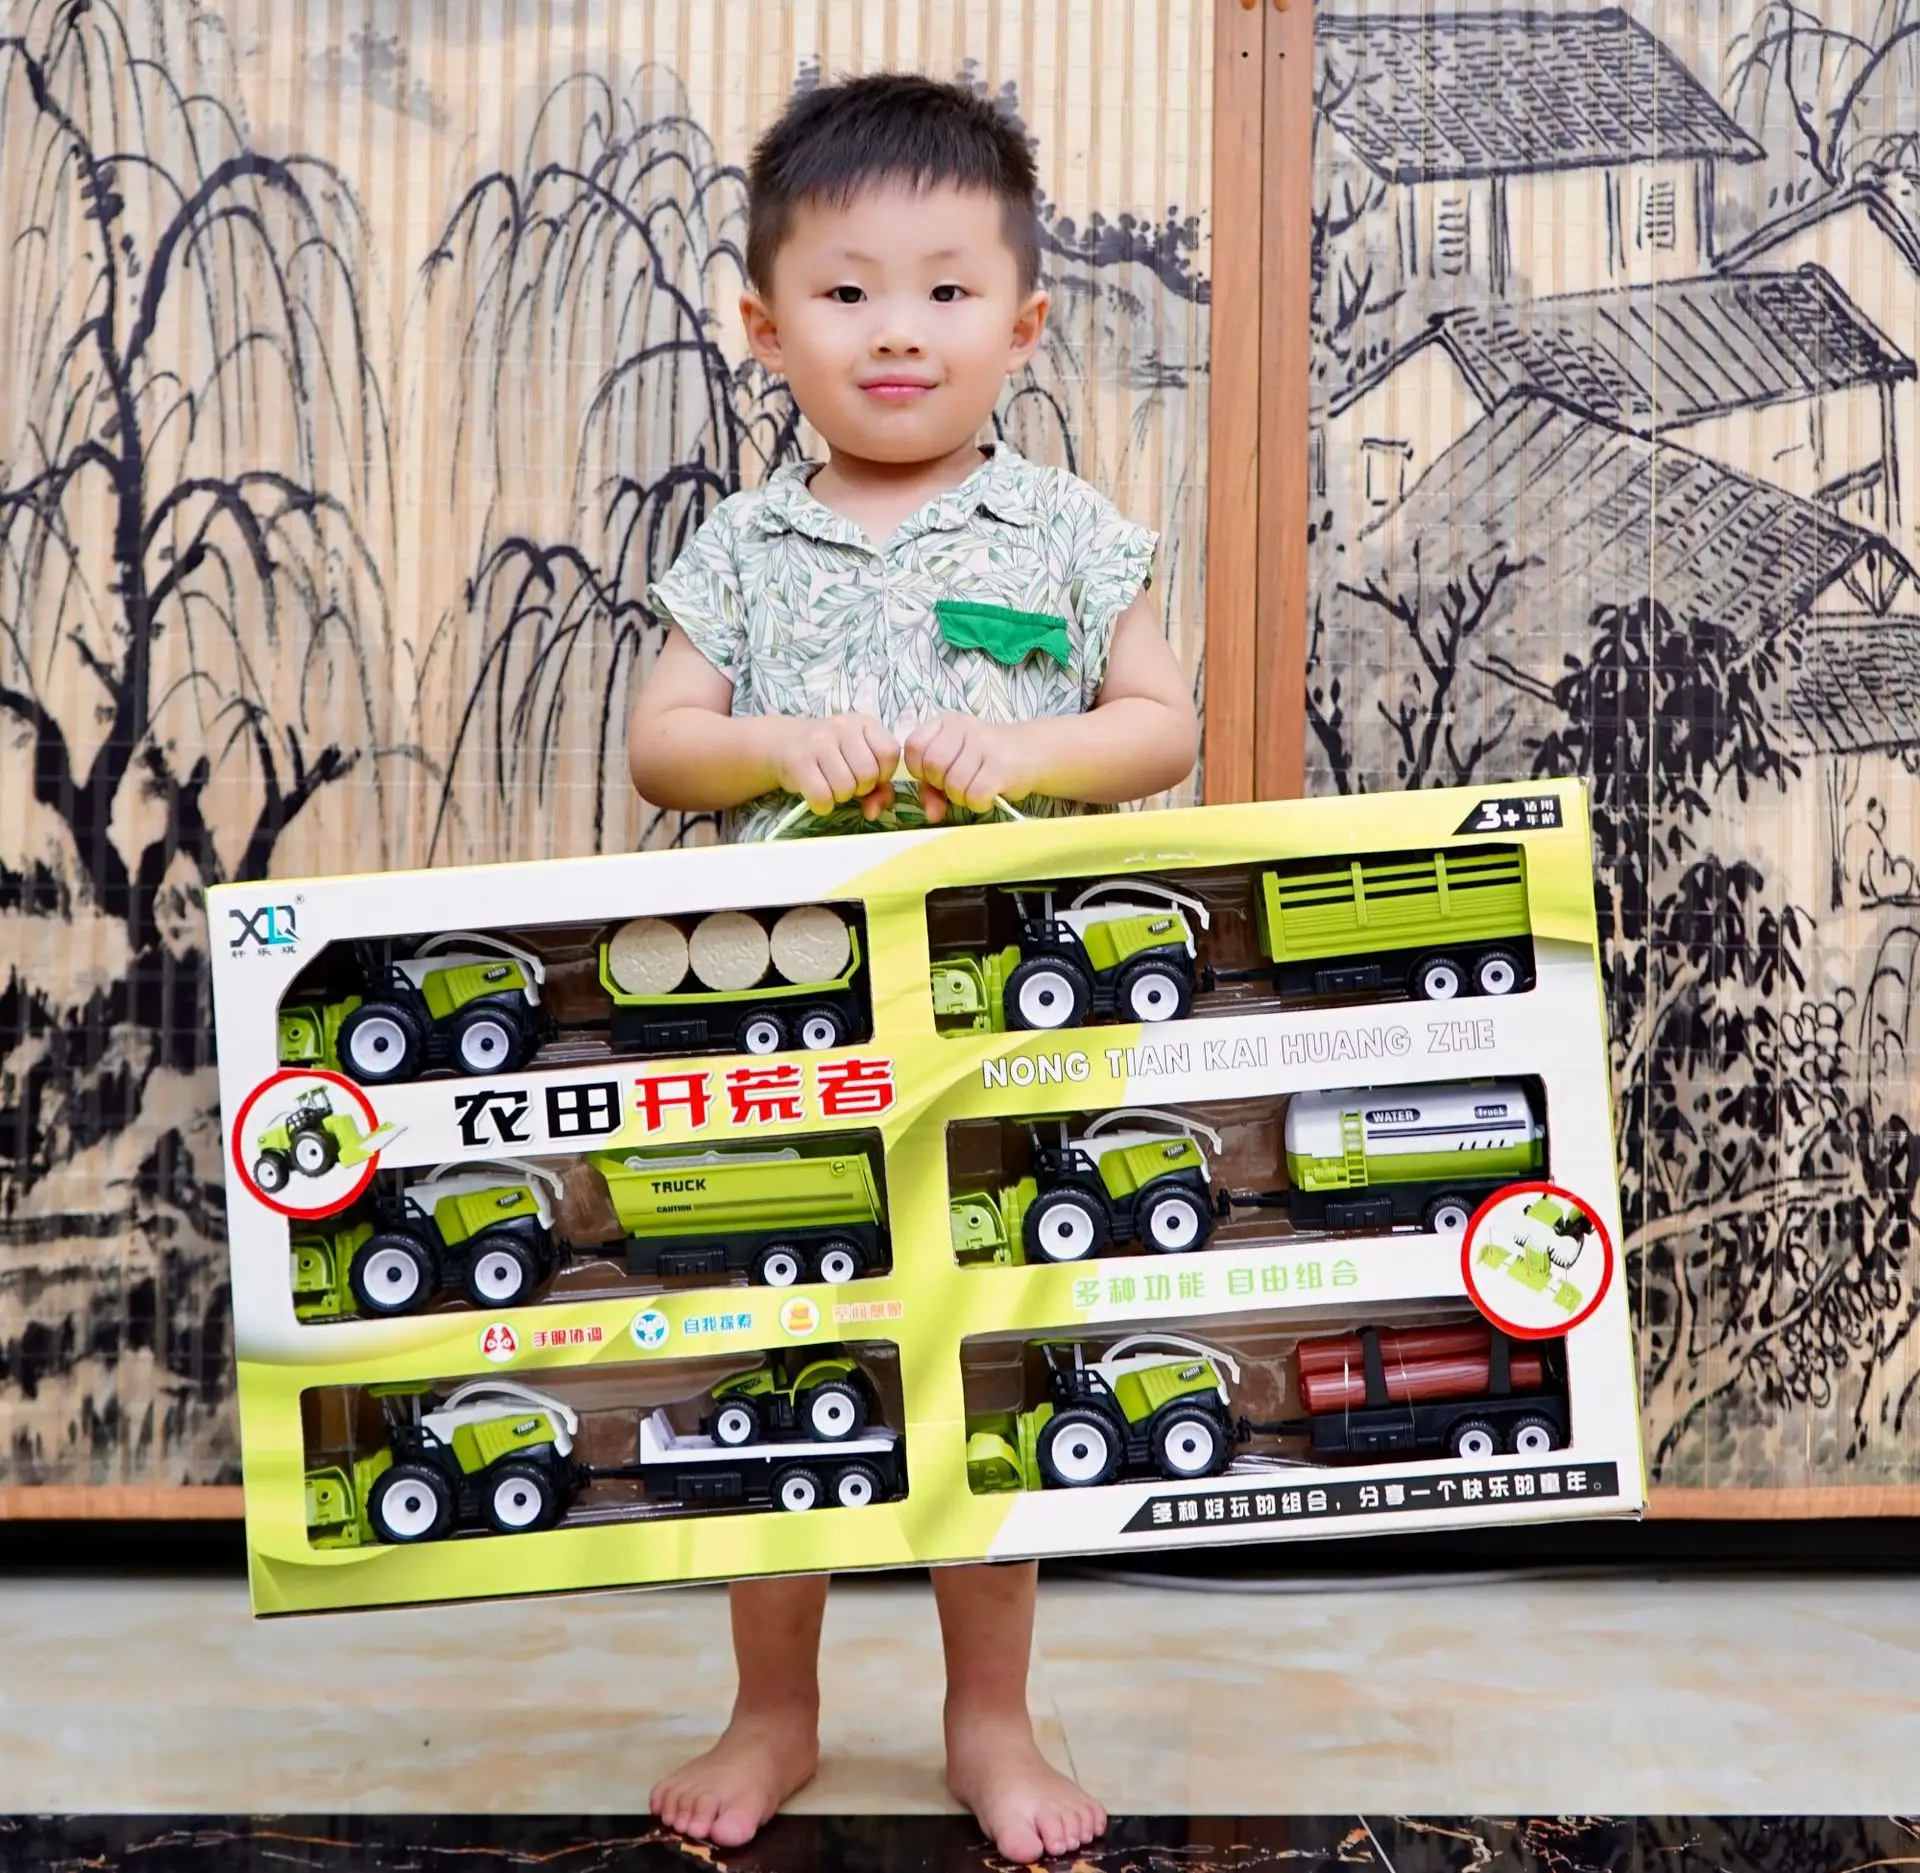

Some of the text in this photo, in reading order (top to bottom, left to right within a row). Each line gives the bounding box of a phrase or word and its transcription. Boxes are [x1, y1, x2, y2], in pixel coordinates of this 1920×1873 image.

[1476, 802, 1520, 830] 3+
[982, 1019, 1496, 1089] NONG TIAN KAI HUANG ZHE
[454, 1059, 895, 1147] 农田开荒者
[1477, 1106, 1505, 1118] Truck
[1372, 1110, 1414, 1124] WATER
[651, 1178, 707, 1194] TRUCK
[656, 1204, 692, 1213] CAUTION
[1075, 1259, 1359, 1308] 多种功能 自由组合
[684, 1313, 752, 1334] 自我探索
[534, 1327, 602, 1346] 手眼协调
